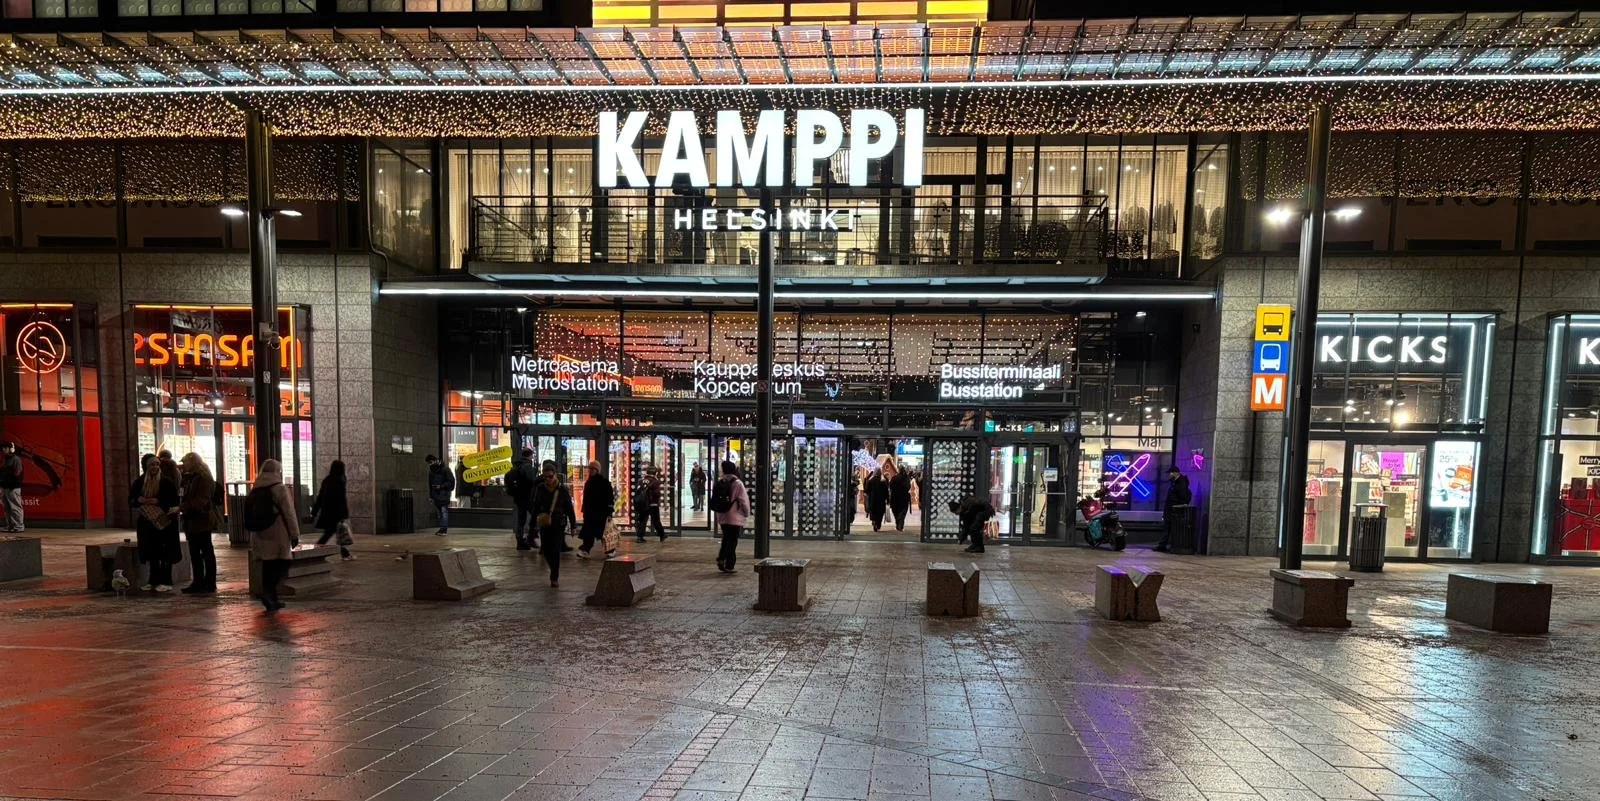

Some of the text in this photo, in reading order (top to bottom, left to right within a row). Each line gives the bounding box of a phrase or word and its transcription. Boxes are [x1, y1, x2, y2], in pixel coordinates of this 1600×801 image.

[598, 108, 925, 188] KAMPPI
[673, 208, 854, 231] HELSINKI
[1320, 336, 1447, 363] KICKS
[1579, 337, 1600, 365] K
[511, 355, 620, 374] Metroasema
[693, 359, 825, 380] Kauppaeskus
[940, 363, 1061, 379] Bussiterminaali
[512, 373, 620, 392] Metrostation
[940, 382, 1023, 398] Busstation
[1254, 377, 1283, 405] M
